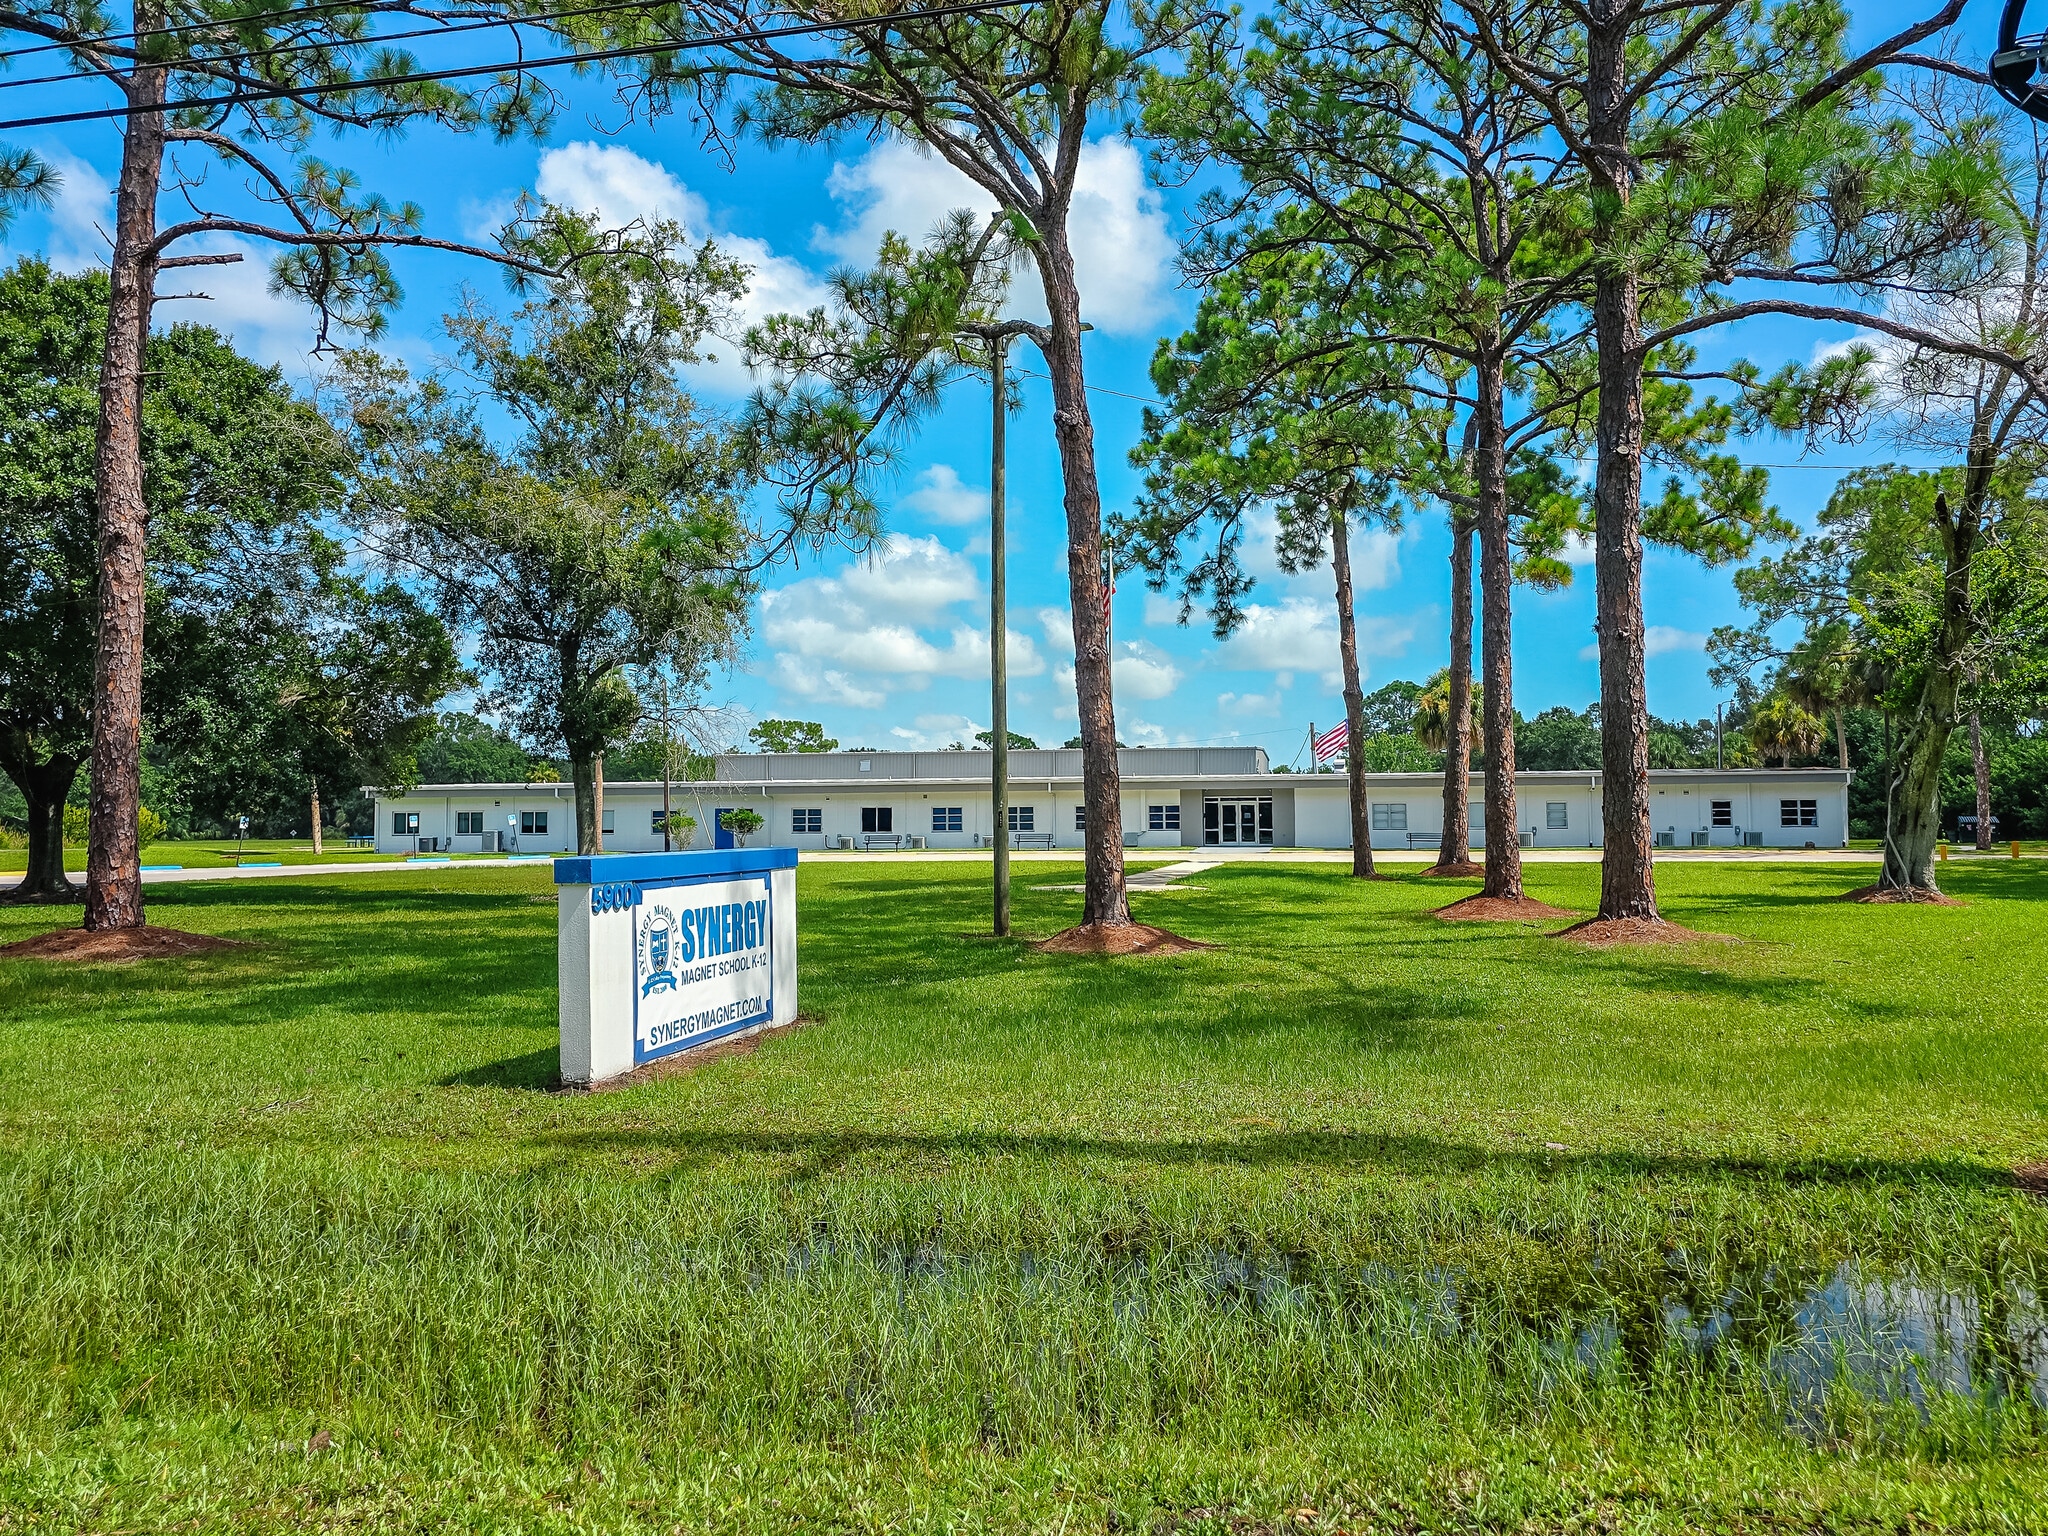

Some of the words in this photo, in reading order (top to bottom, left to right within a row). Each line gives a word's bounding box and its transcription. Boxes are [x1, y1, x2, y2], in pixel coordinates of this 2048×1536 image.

[592, 883, 633, 915] 5900
[638, 911, 651, 976] SYNERGY
[654, 904, 678, 934] MAGNET
[681, 899, 767, 963] SYNERGY
[681, 963, 717, 986] MAGNET
[718, 957, 750, 976] SCHOOL
[751, 952, 767, 969] K-12
[650, 995, 763, 1046] SYNERGYMAGNET.COM
